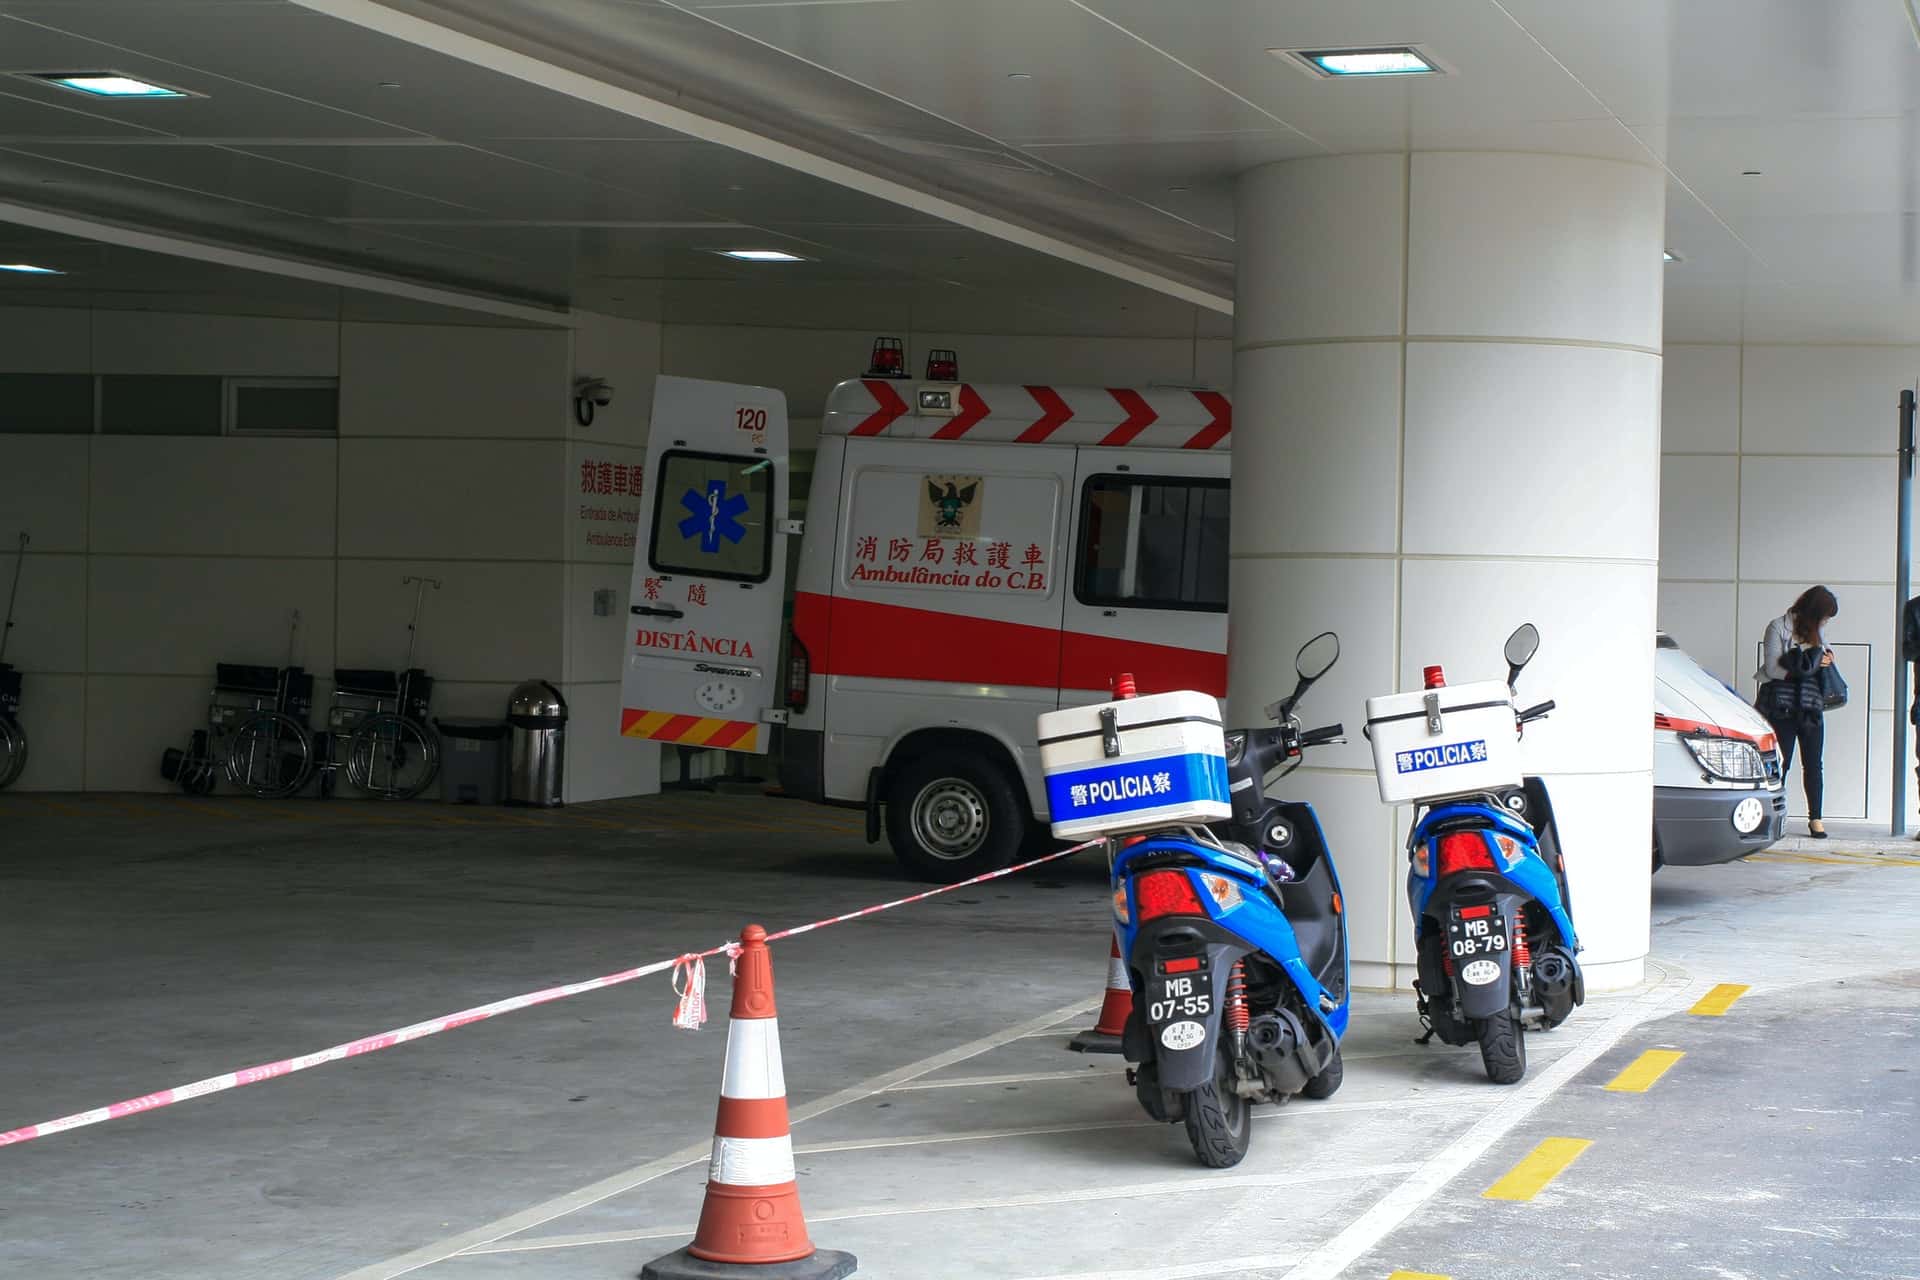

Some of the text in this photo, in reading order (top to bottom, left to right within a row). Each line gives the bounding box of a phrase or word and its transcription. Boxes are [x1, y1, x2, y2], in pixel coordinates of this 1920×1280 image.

[736, 408, 767, 431] 120
[856, 536, 1045, 570] 消防局救護車
[850, 563, 1047, 590] Ambulância do C.B.
[635, 629, 753, 659] DISTÂNCIA
[1464, 920, 1489, 937] MB
[1453, 935, 1505, 956] 08-79
[1165, 978, 1192, 998] MB
[1151, 995, 1210, 1020] 07-55
